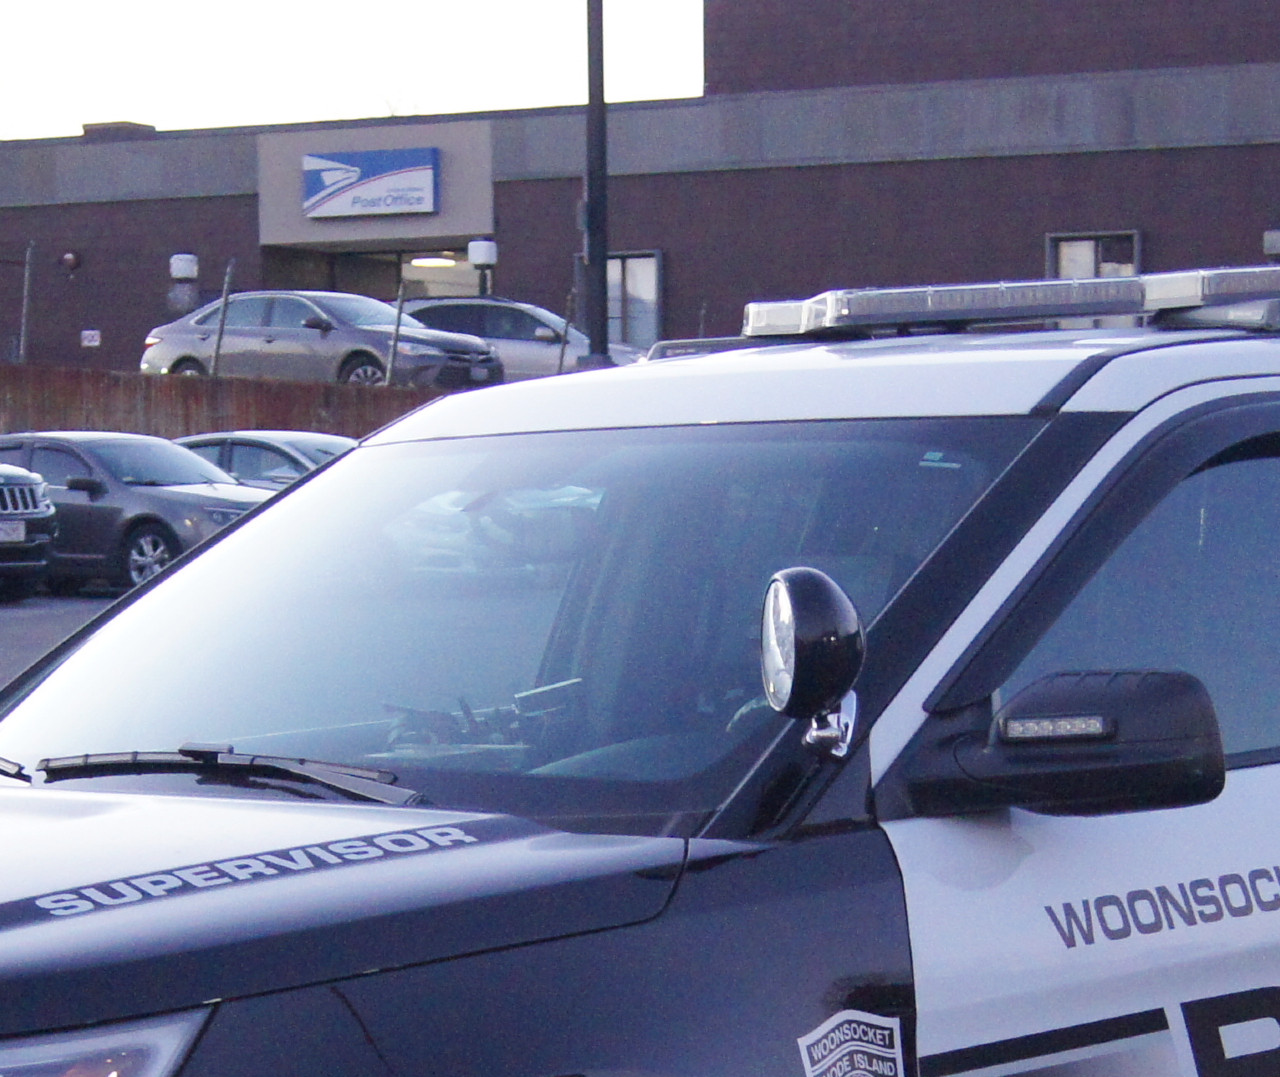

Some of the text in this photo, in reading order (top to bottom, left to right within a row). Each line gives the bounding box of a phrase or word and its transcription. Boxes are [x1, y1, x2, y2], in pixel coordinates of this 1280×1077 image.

[35, 826, 478, 917] SUPERVISOR
[811, 1023, 891, 1060] WOONSOCKET
[853, 1053, 896, 1076] ISLAND
